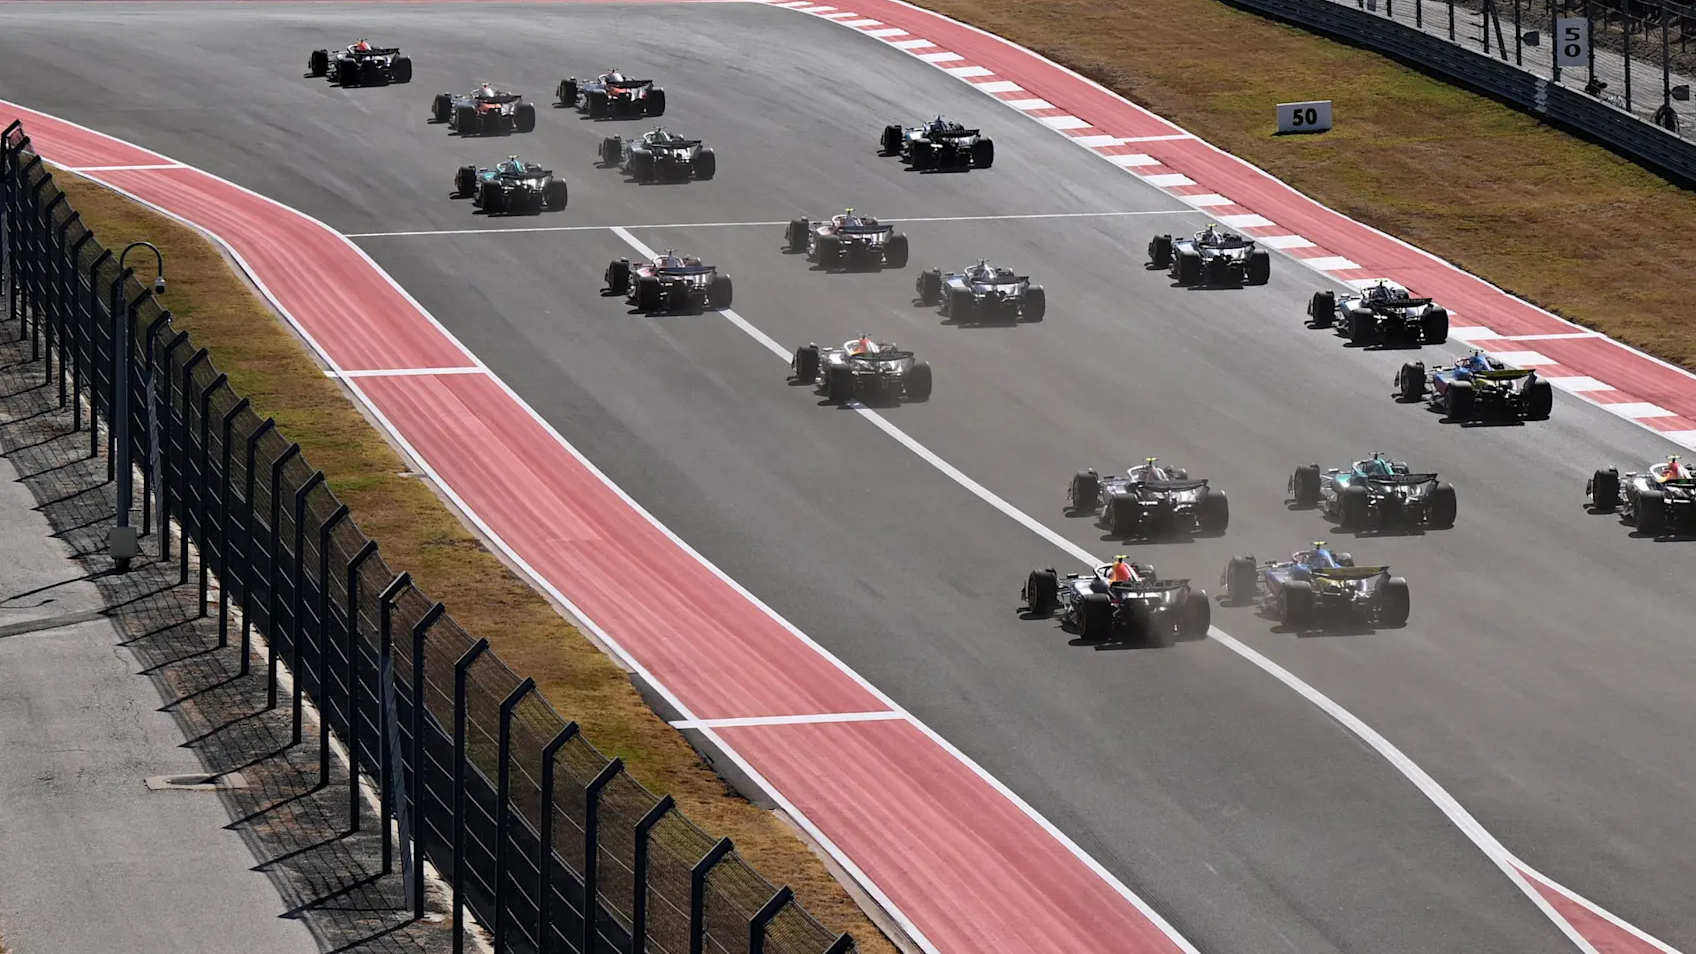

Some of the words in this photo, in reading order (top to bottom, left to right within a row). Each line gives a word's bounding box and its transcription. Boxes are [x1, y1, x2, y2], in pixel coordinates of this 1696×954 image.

[1564, 27, 1582, 58] 50
[1292, 108, 1318, 126] 50
[1120, 581, 1181, 589] ORACLE
